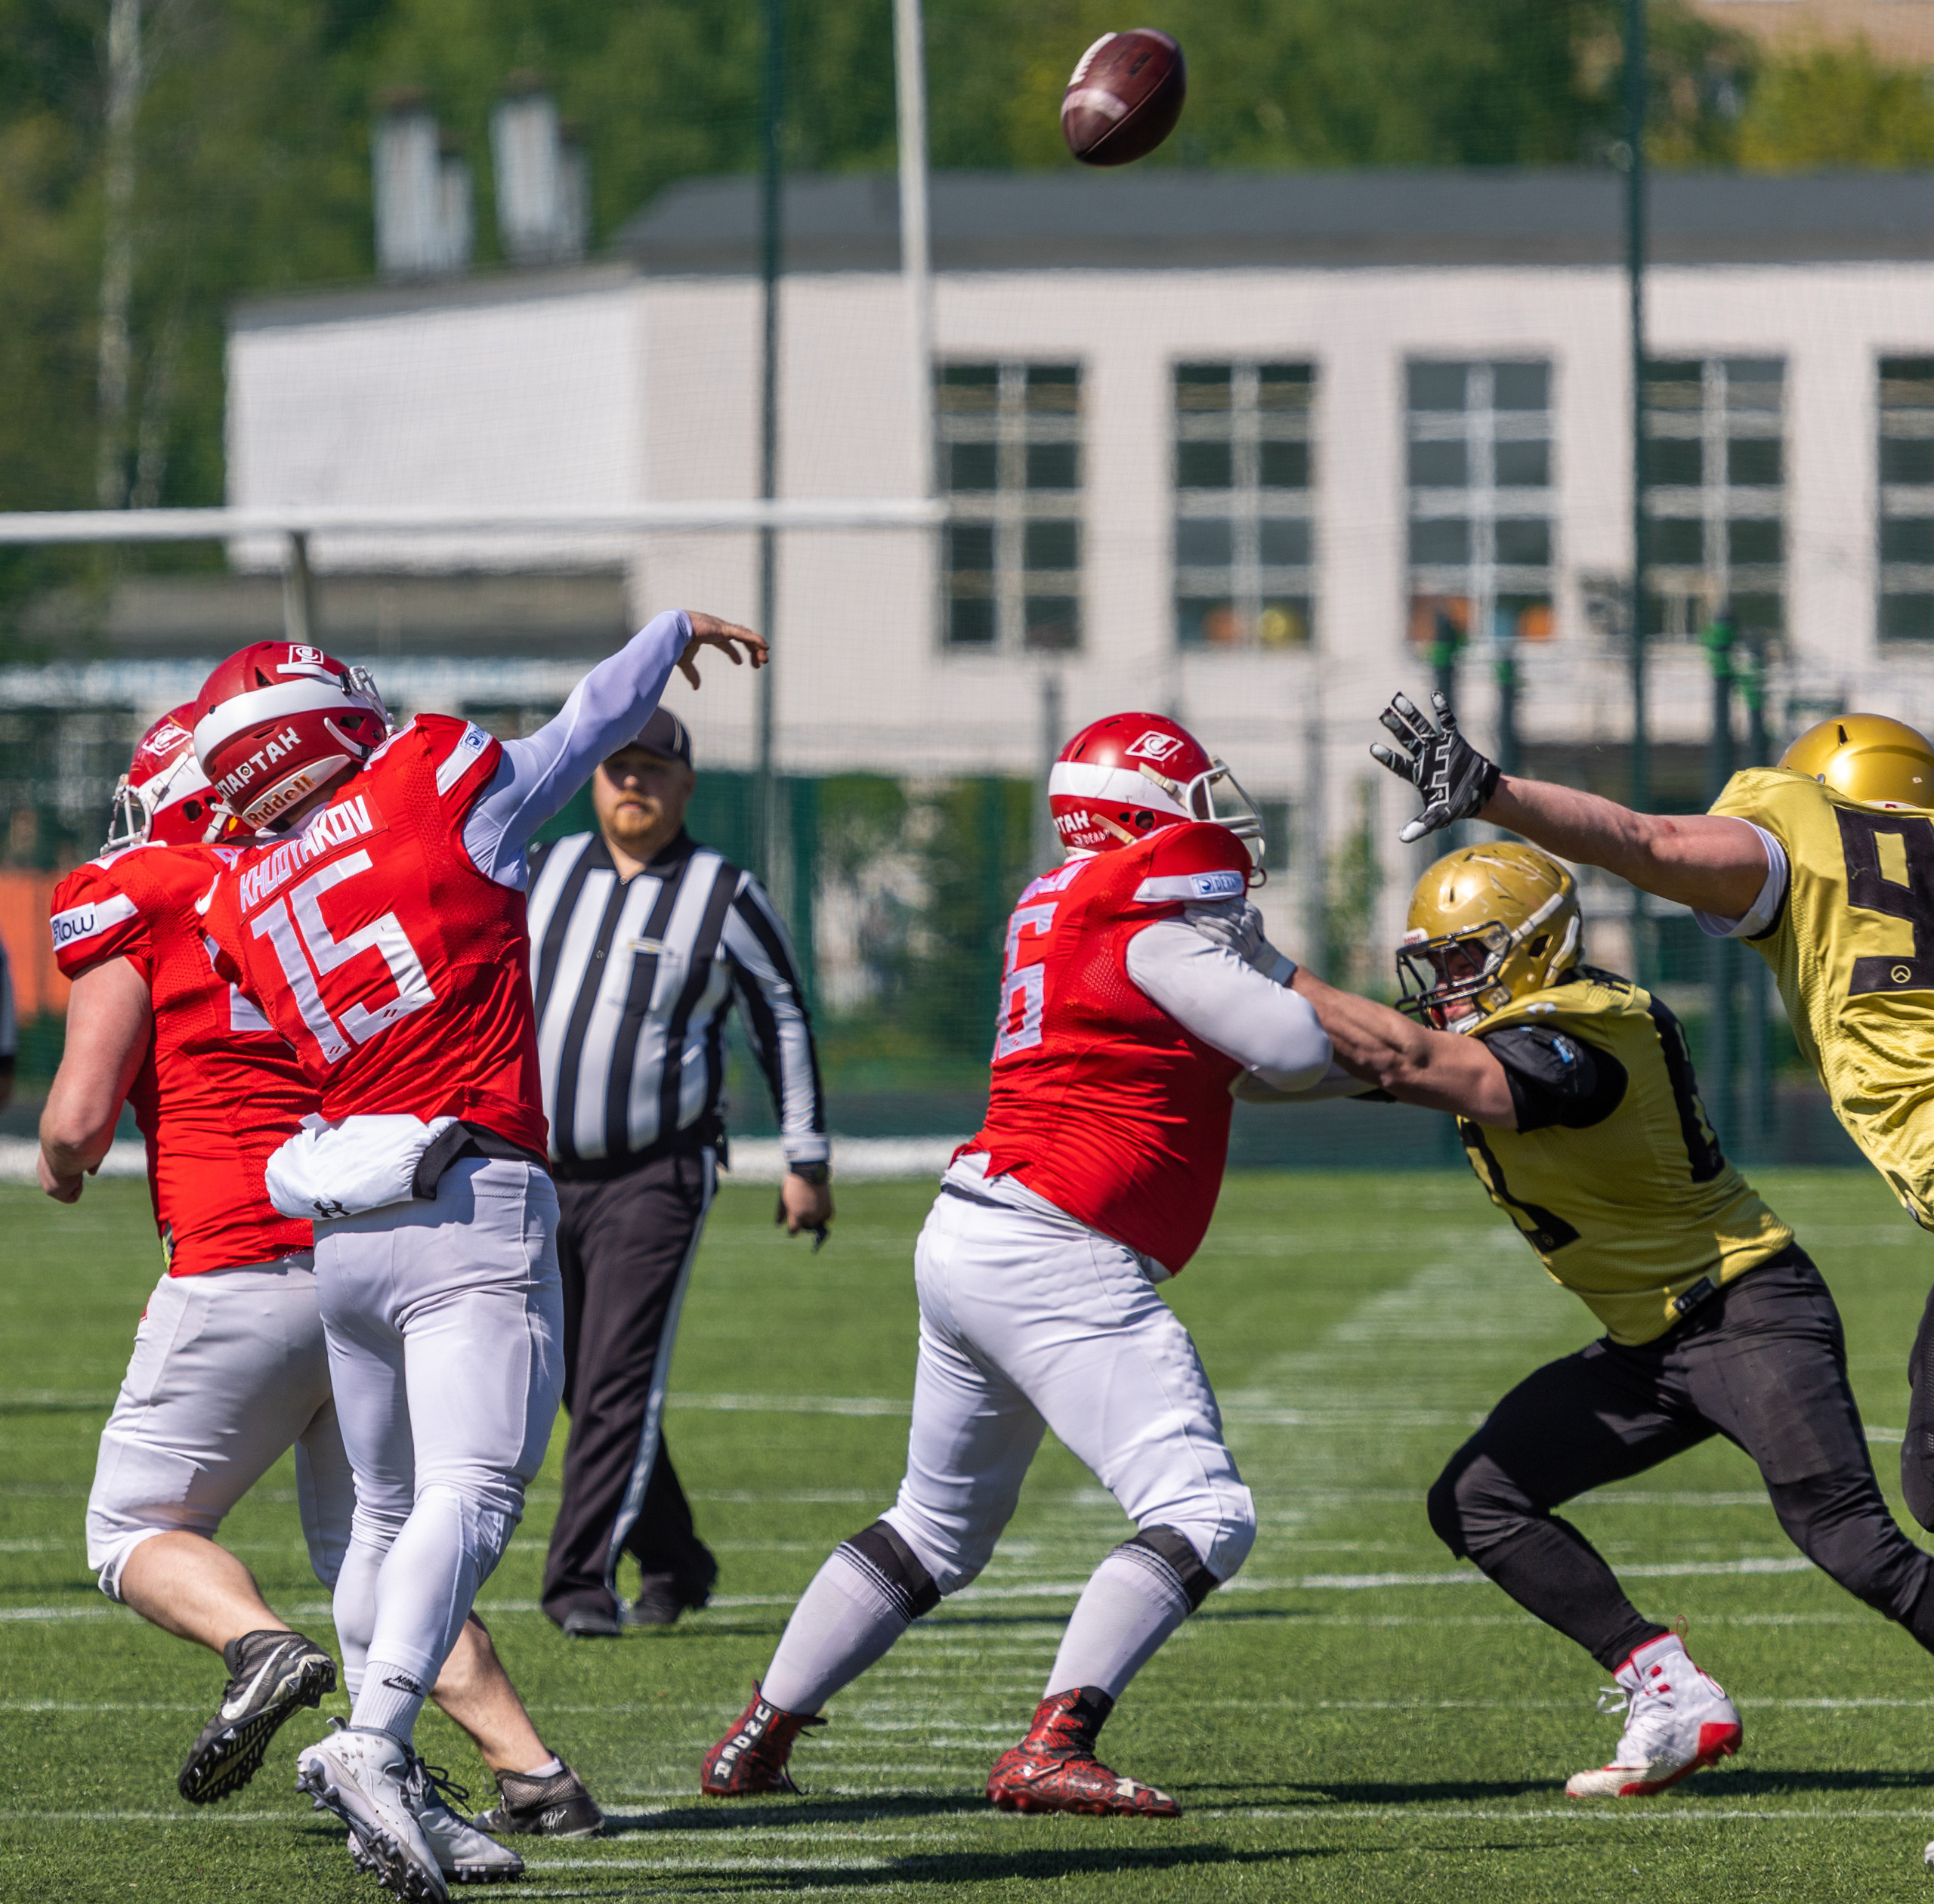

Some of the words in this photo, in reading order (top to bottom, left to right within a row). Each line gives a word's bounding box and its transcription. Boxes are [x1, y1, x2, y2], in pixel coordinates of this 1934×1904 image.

[239, 794, 374, 913] KHUDYAKOV
[246, 773, 315, 827] Riddell
[250, 848, 437, 1065] 15
[990, 901, 1059, 1063] 6
